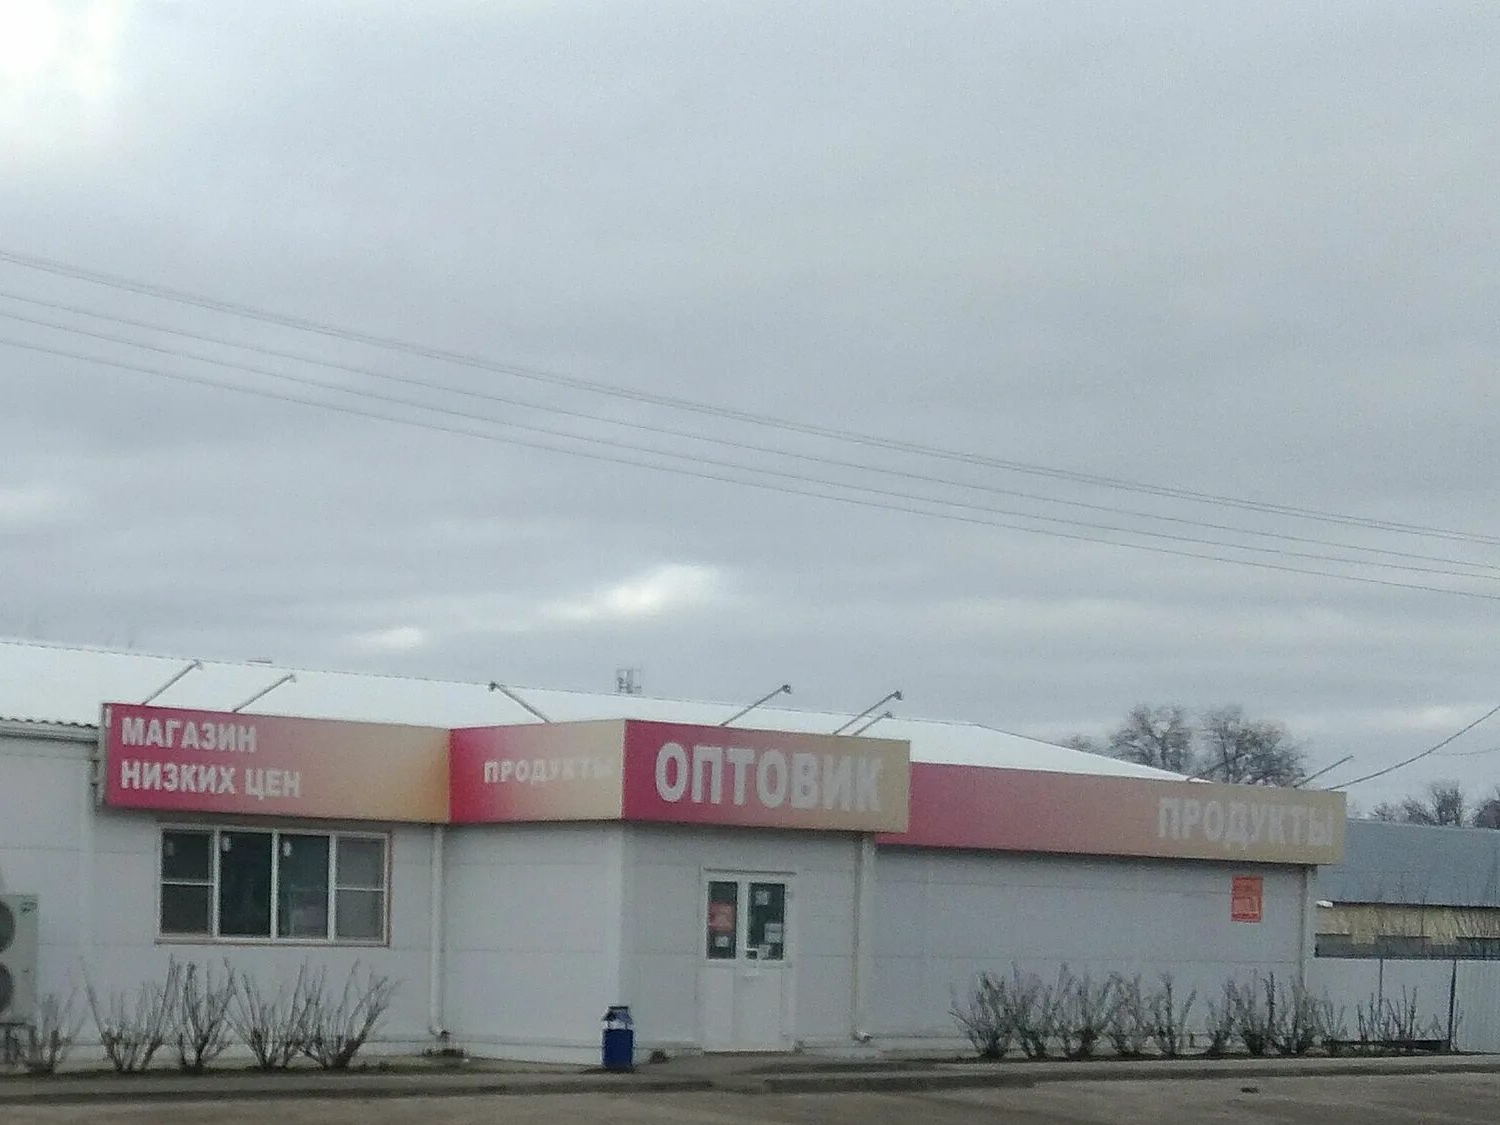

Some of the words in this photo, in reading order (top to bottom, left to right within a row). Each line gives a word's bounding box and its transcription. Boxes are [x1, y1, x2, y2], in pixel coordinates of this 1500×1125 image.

[120, 716, 258, 753] МАГАЗИН
[120, 759, 236, 795] НИЗКИХ
[244, 767, 301, 800] ЦЕН
[655, 742, 884, 812] ОПТОВИК
[1158, 797, 1333, 850] ПРОДУКТЫ
